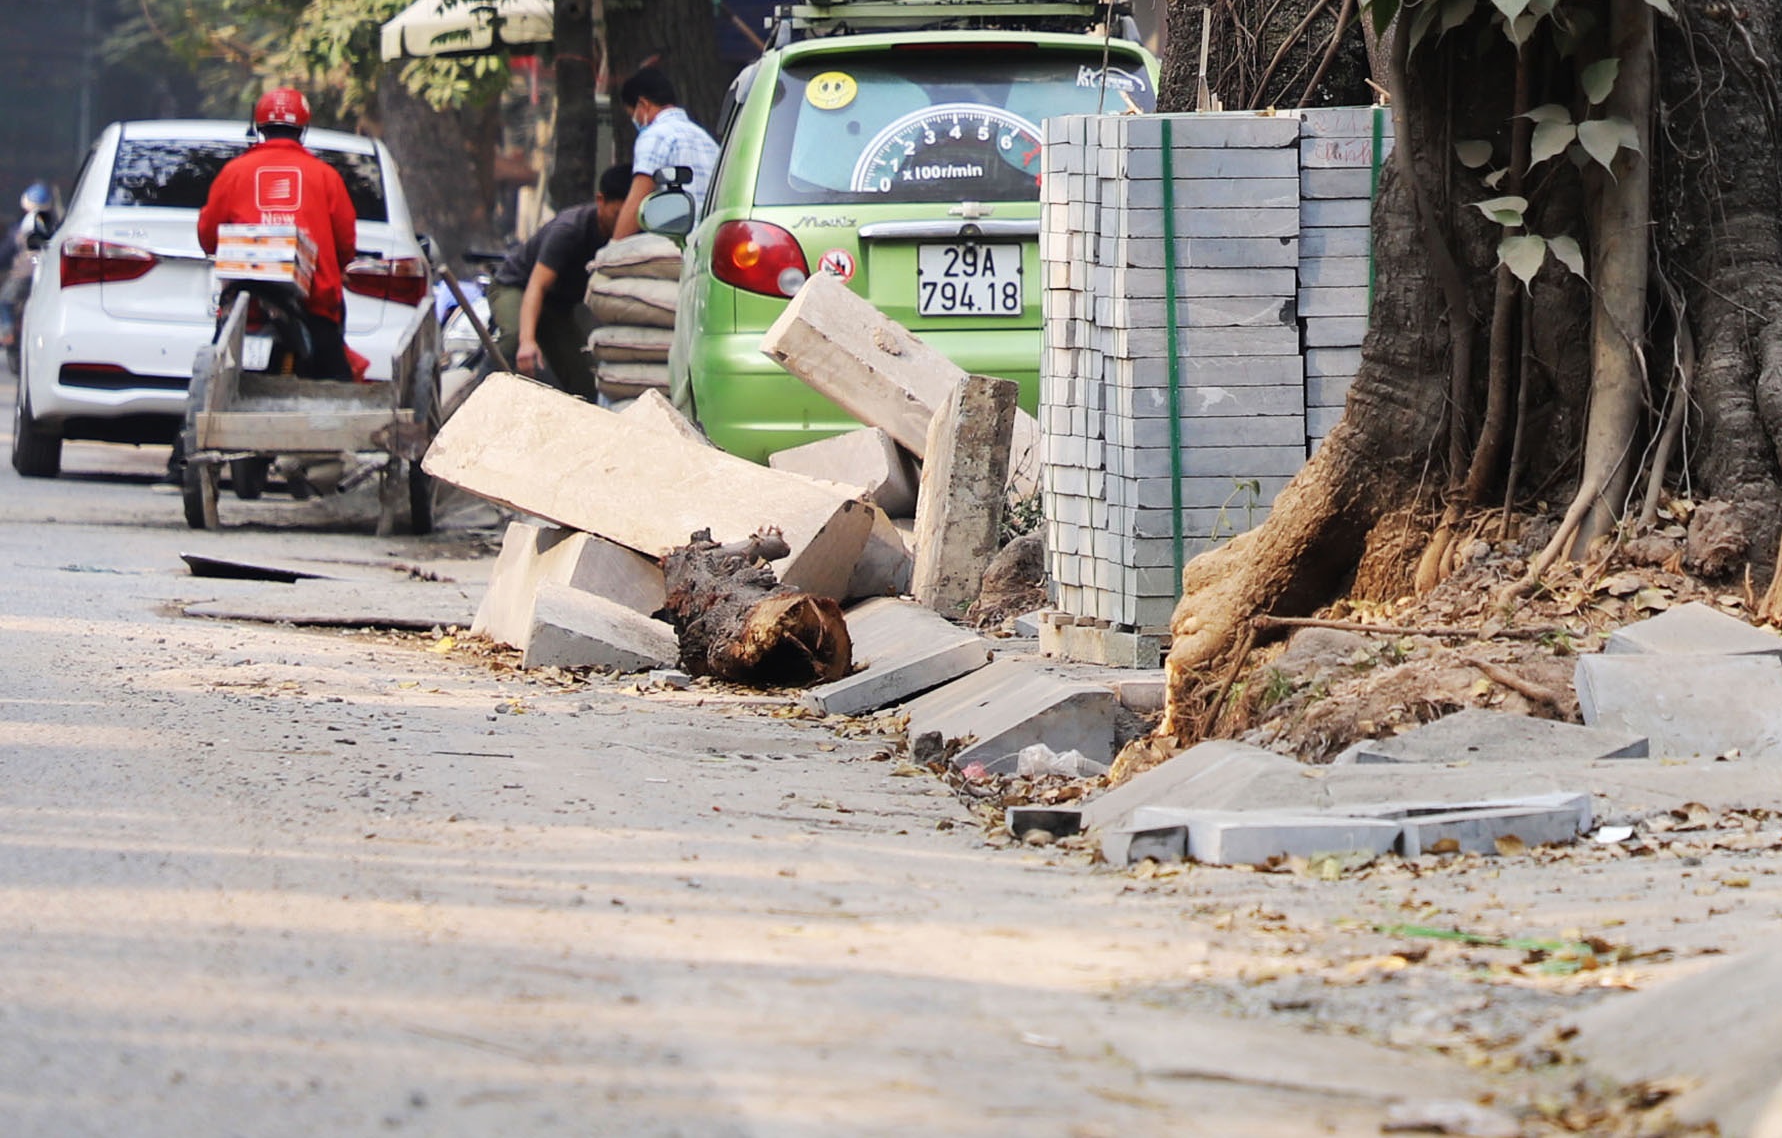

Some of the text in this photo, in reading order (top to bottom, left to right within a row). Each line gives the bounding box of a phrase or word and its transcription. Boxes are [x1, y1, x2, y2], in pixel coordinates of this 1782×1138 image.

[880, 177, 891, 192] 0
[890, 158, 899, 173] 1
[903, 141, 916, 156] 2
[924, 130, 936, 145] 3
[949, 125, 962, 140] 4
[977, 126, 990, 141] 5
[1000, 135, 1013, 150] 6
[943, 247, 996, 278] 29A
[922, 281, 1018, 312] 794.18
